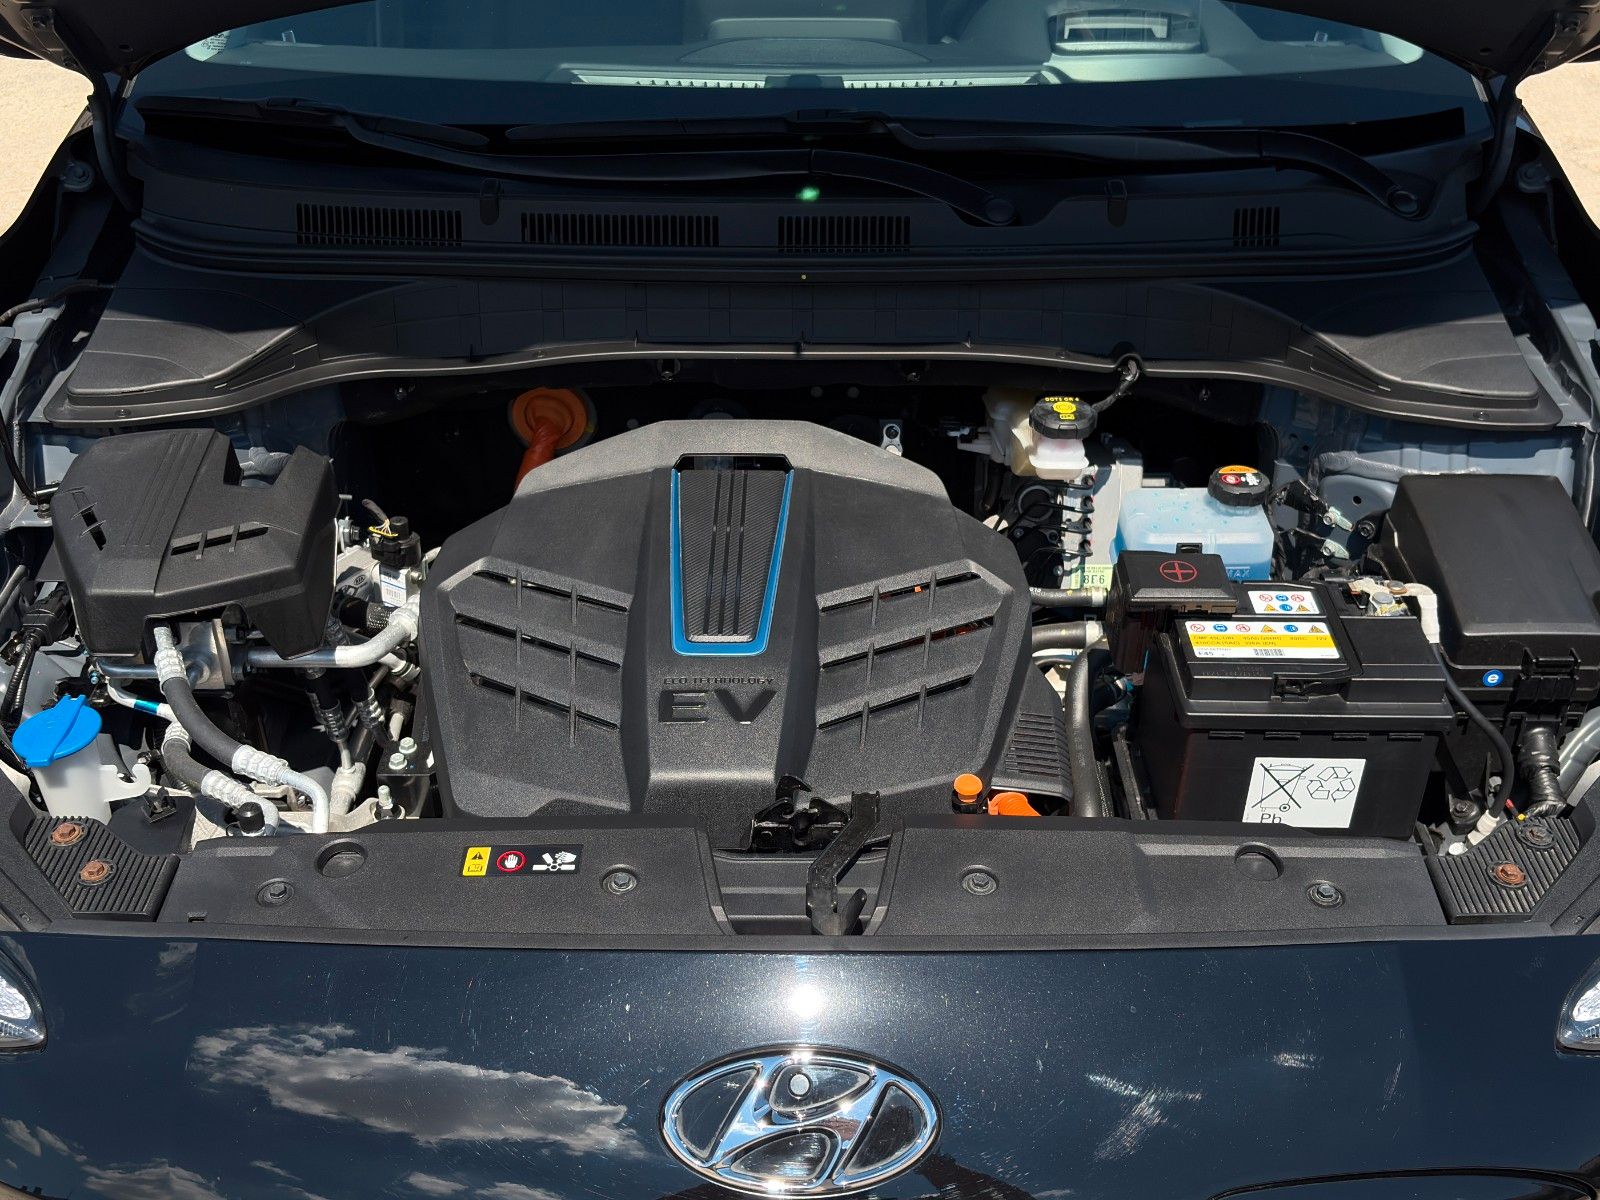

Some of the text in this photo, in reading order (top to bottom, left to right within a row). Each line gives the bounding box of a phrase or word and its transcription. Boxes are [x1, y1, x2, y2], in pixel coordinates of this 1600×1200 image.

[663, 676, 774, 685] ECO TECHNOLOGY
[658, 688, 778, 725] EV
[1260, 813, 1282, 824] Pb
